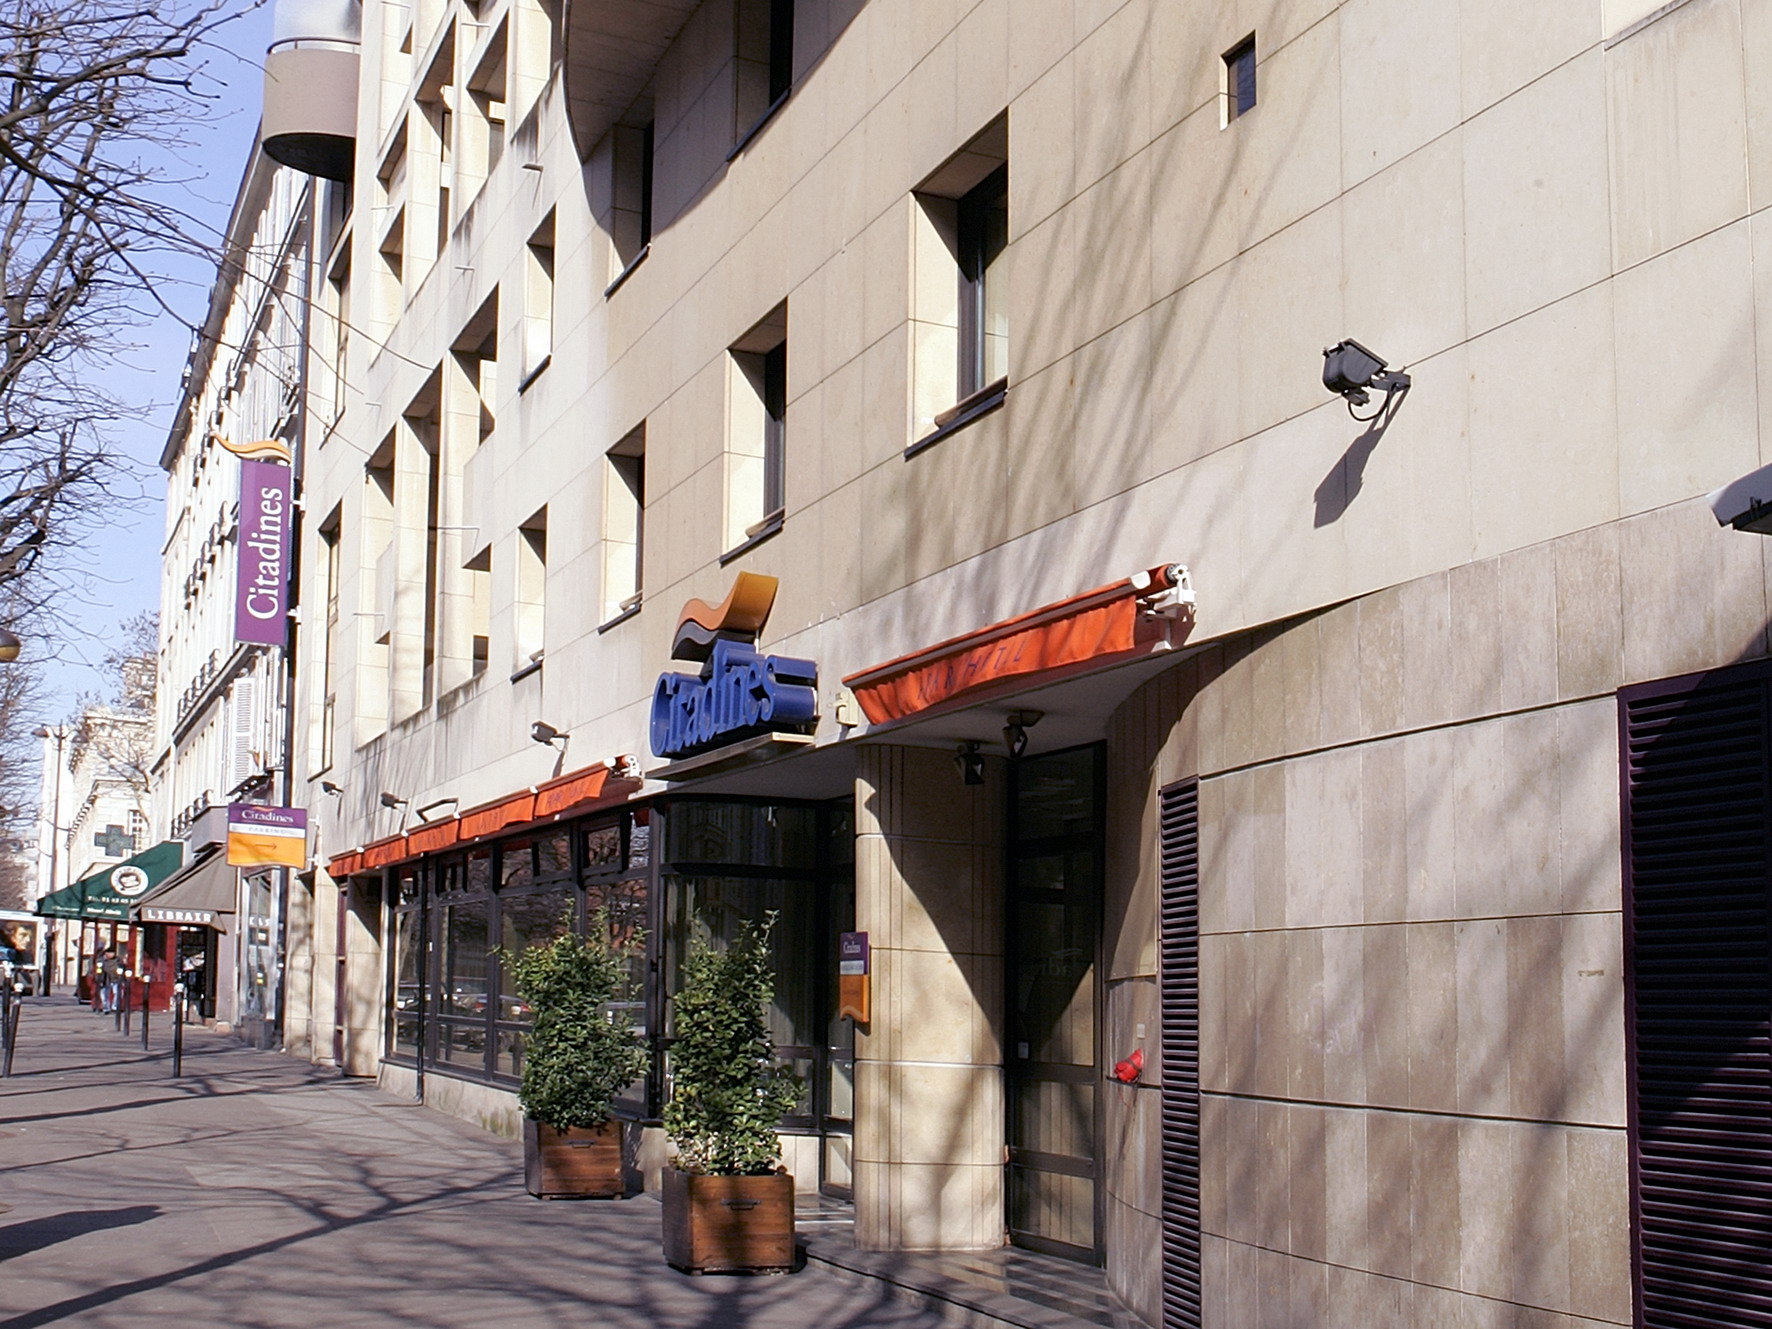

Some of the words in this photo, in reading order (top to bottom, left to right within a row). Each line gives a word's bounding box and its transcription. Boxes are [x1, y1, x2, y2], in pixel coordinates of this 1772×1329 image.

[246, 487, 283, 620] Citadines
[650, 639, 815, 758] Citadines
[241, 809, 294, 823] Citadines
